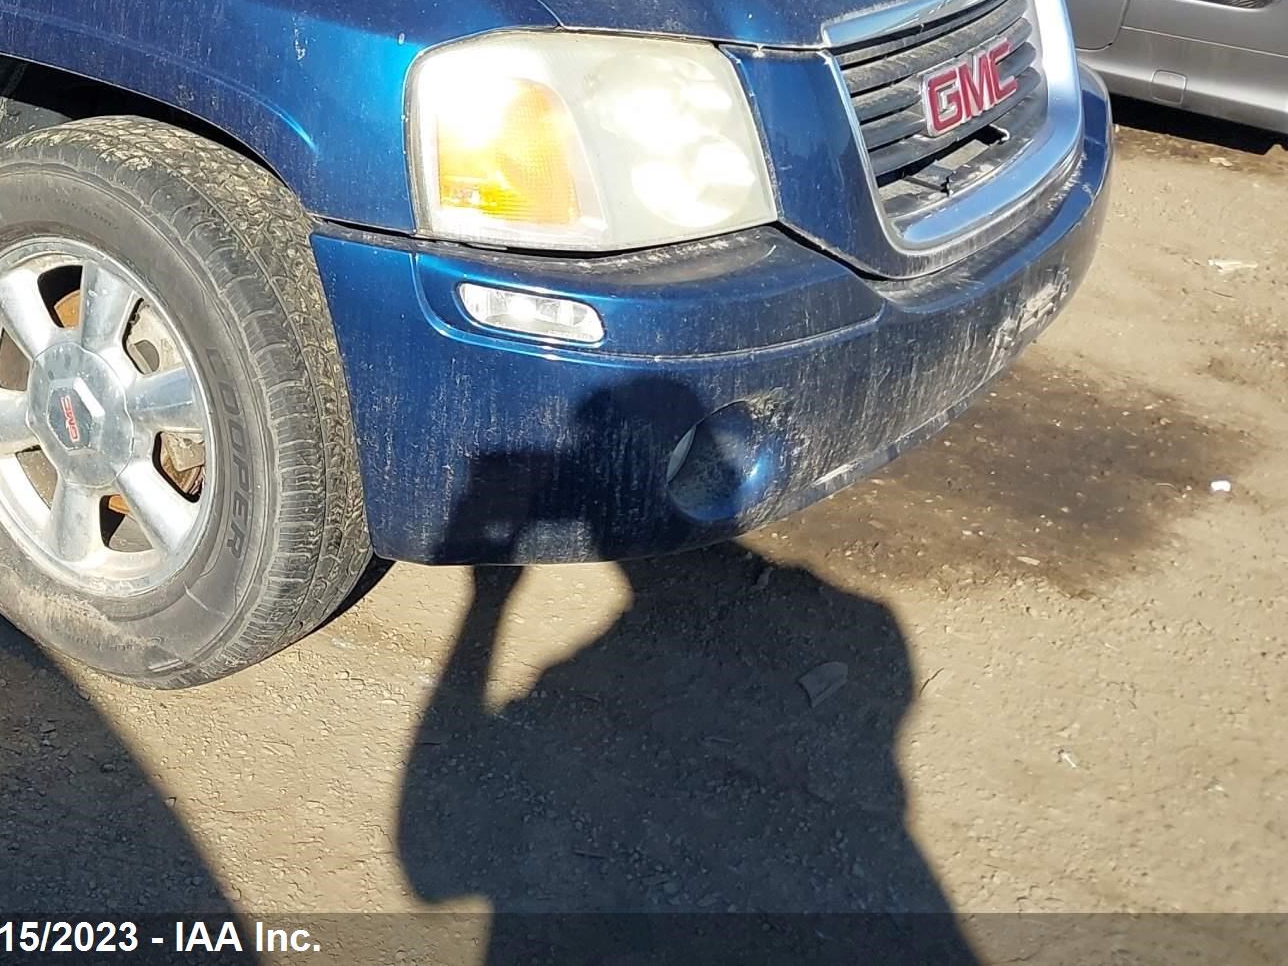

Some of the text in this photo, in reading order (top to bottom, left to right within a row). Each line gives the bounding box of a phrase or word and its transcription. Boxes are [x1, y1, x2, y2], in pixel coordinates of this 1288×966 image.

[922, 38, 1018, 136] GMC
[60, 395, 80, 442] GMC
[206, 347, 250, 559] COOPER
